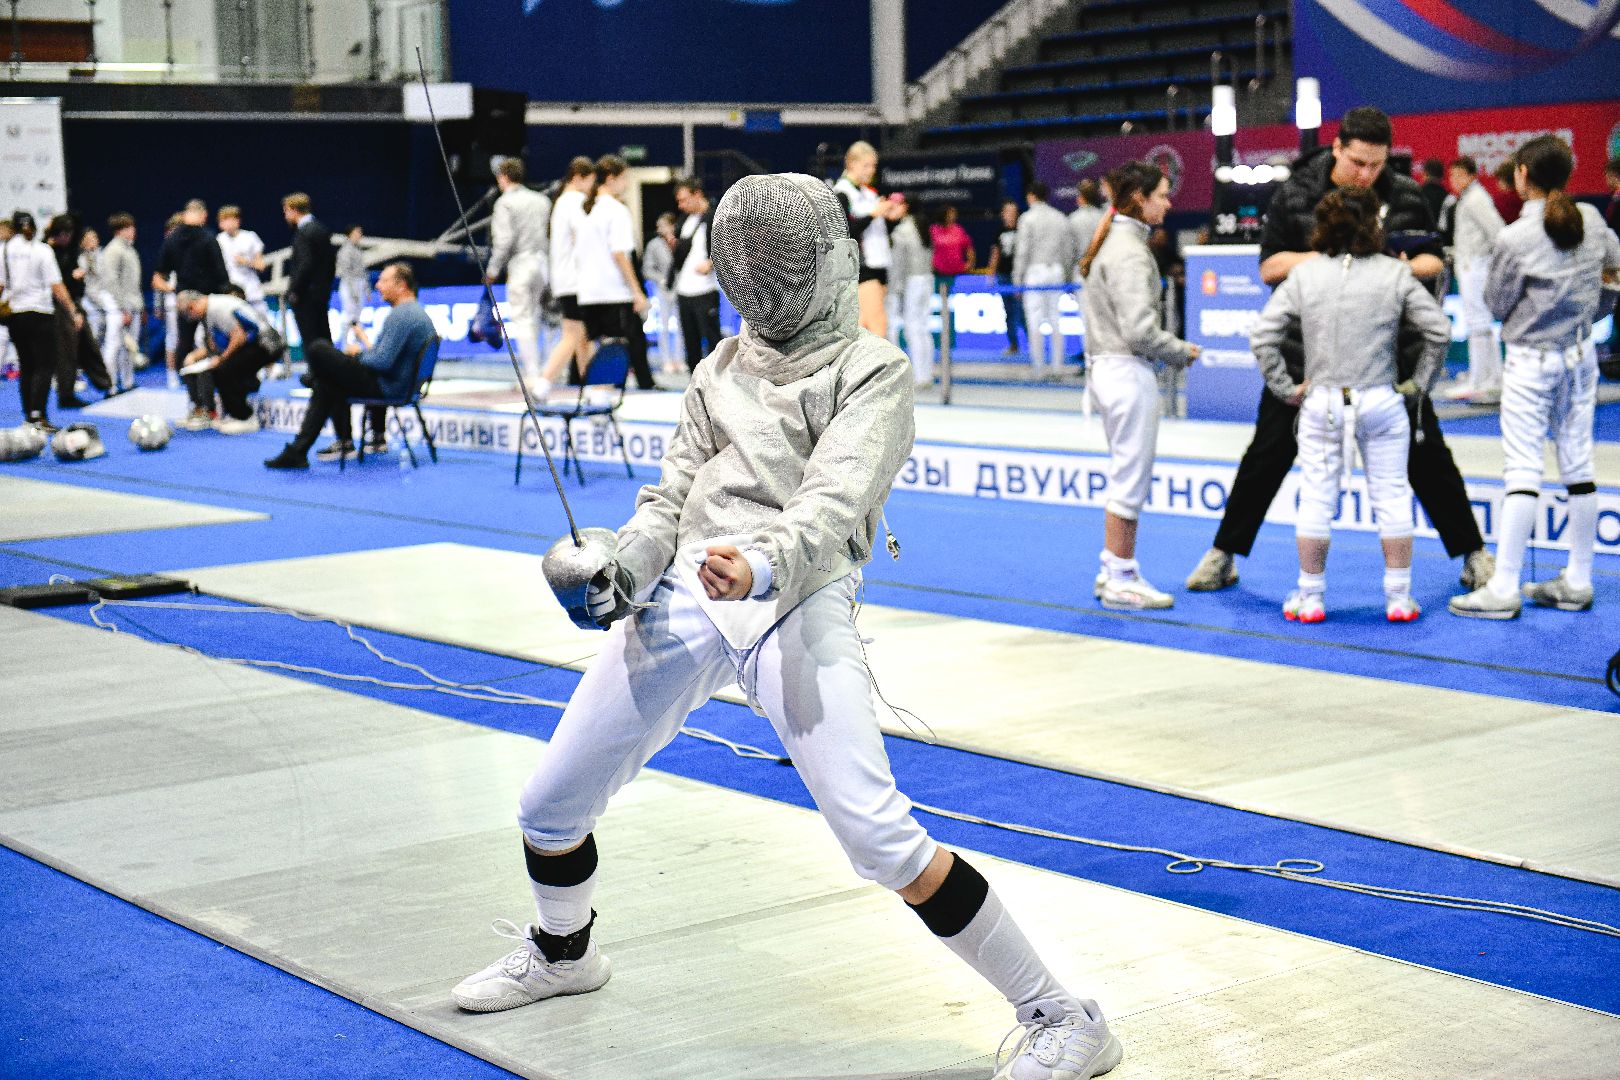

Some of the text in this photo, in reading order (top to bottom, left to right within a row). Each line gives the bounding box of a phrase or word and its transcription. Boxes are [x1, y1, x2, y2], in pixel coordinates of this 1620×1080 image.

[523, 426, 664, 460] СОРЕВНОВ
[901, 456, 950, 488] ЗЫ
[974, 460, 1229, 512] ДВУКРТНО
